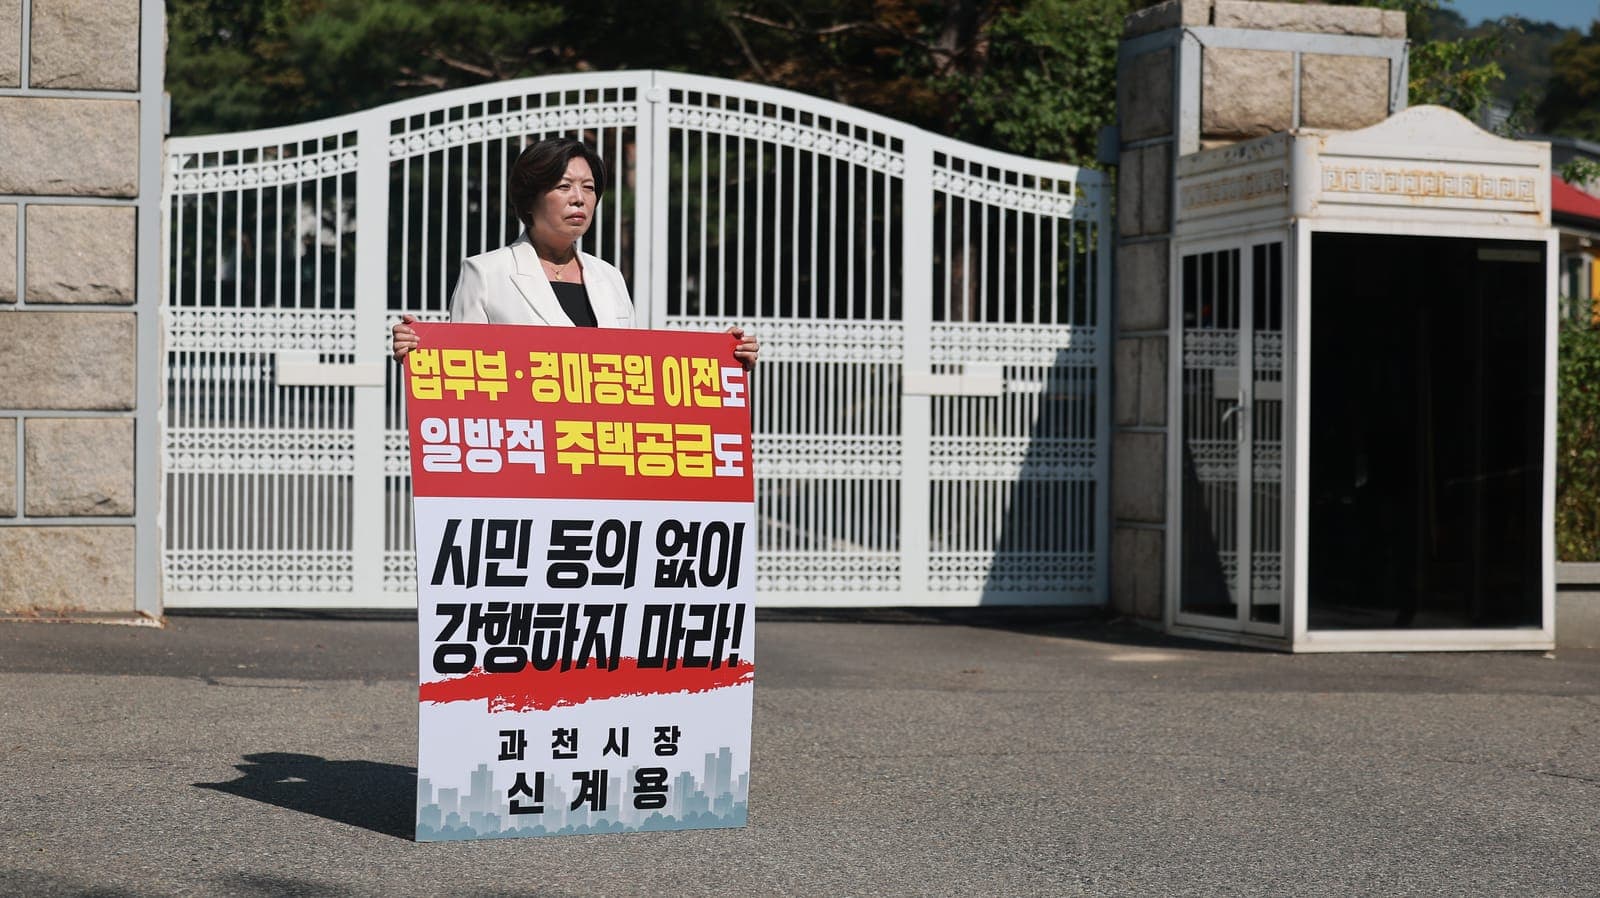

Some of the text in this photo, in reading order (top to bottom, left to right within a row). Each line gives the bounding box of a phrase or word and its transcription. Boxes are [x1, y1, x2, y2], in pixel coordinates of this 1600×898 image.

[662, 356, 746, 408] 이전도
[420, 417, 744, 478] 일방적 주택공급도
[431, 519, 746, 590] 시민 동의 없이
[432, 602, 746, 674] 강행하지 마라!
